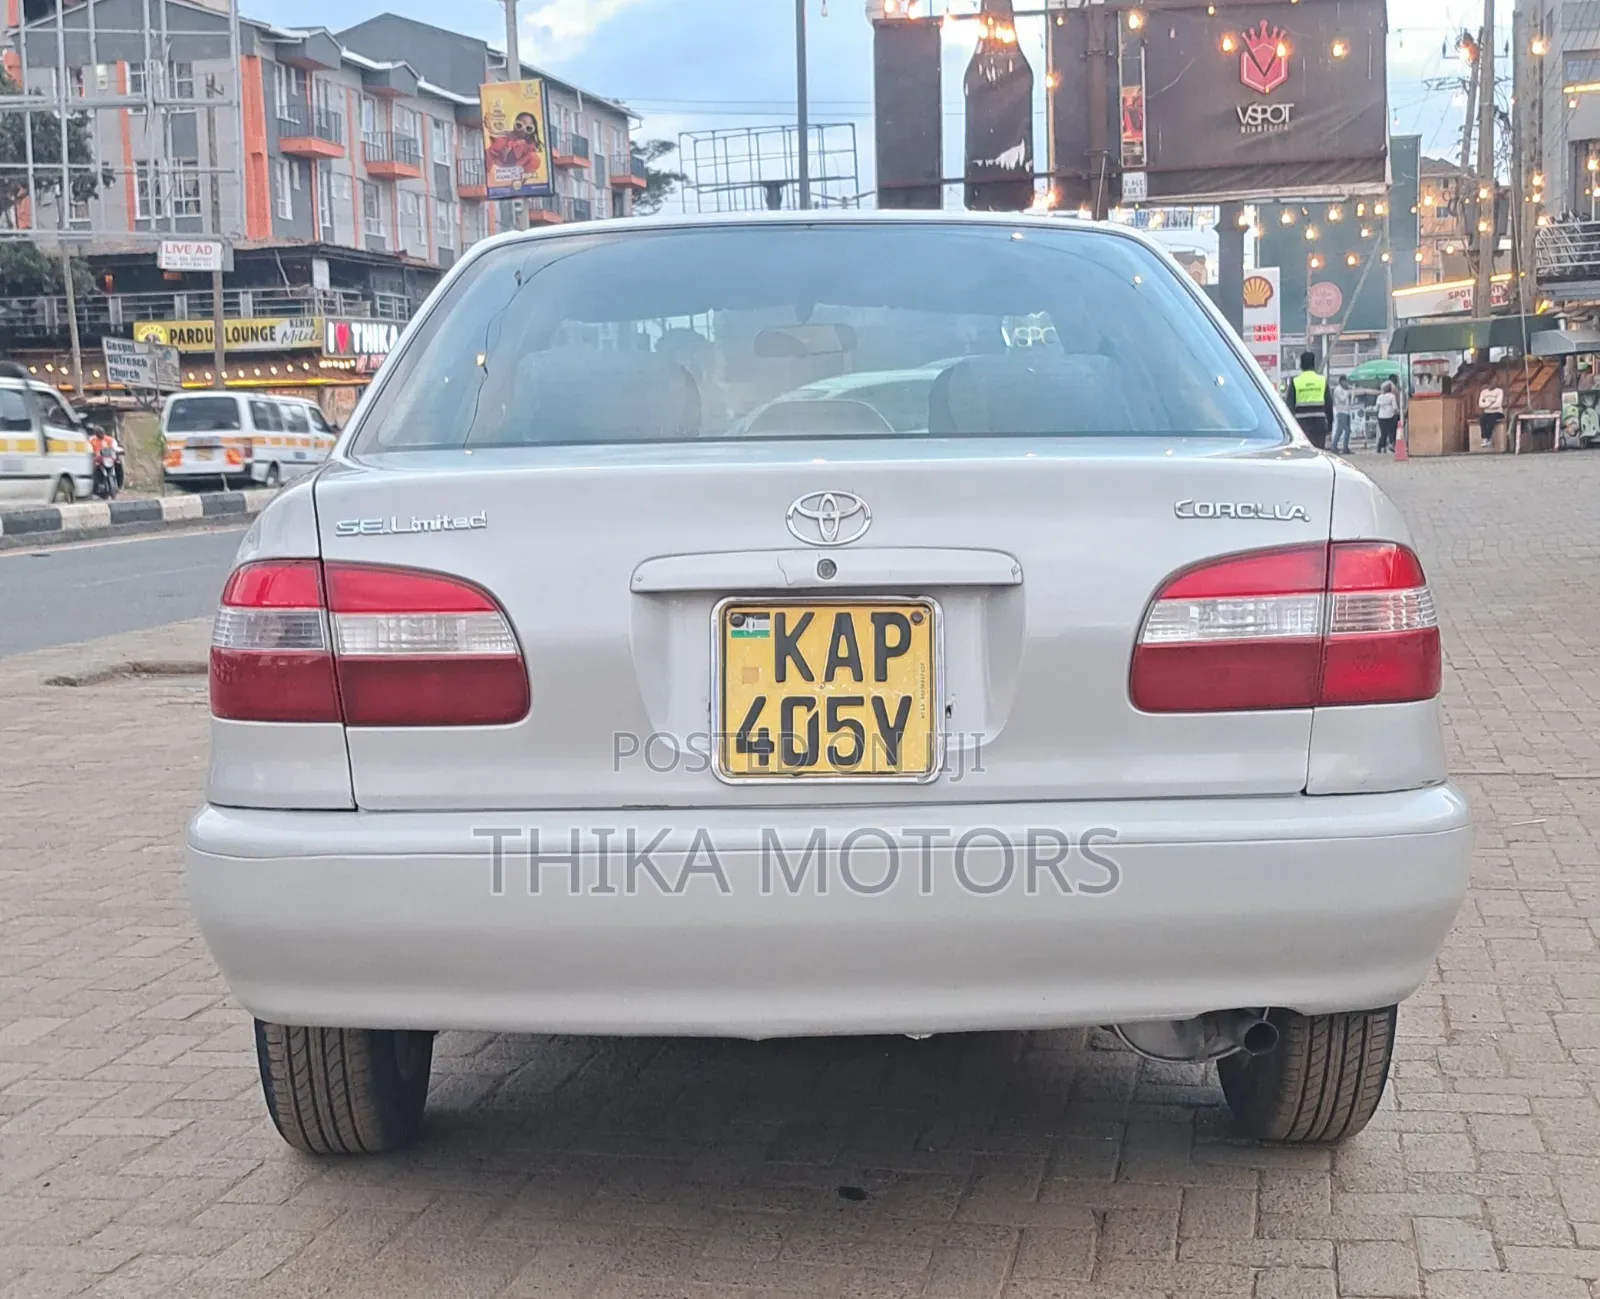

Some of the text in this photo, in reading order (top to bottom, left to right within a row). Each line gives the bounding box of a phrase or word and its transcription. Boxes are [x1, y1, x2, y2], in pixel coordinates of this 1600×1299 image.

[1236, 103, 1295, 125] VSPOT
[165, 244, 213, 255] LIVE AD
[1447, 288, 1471, 300] SPOT
[225, 325, 277, 343] LOUNGE
[351, 322, 399, 354] THIKA
[107, 354, 148, 368] Outreach
[109, 367, 141, 380] Church
[774, 611, 912, 683] KAP
[735, 695, 913, 767] 405Y
